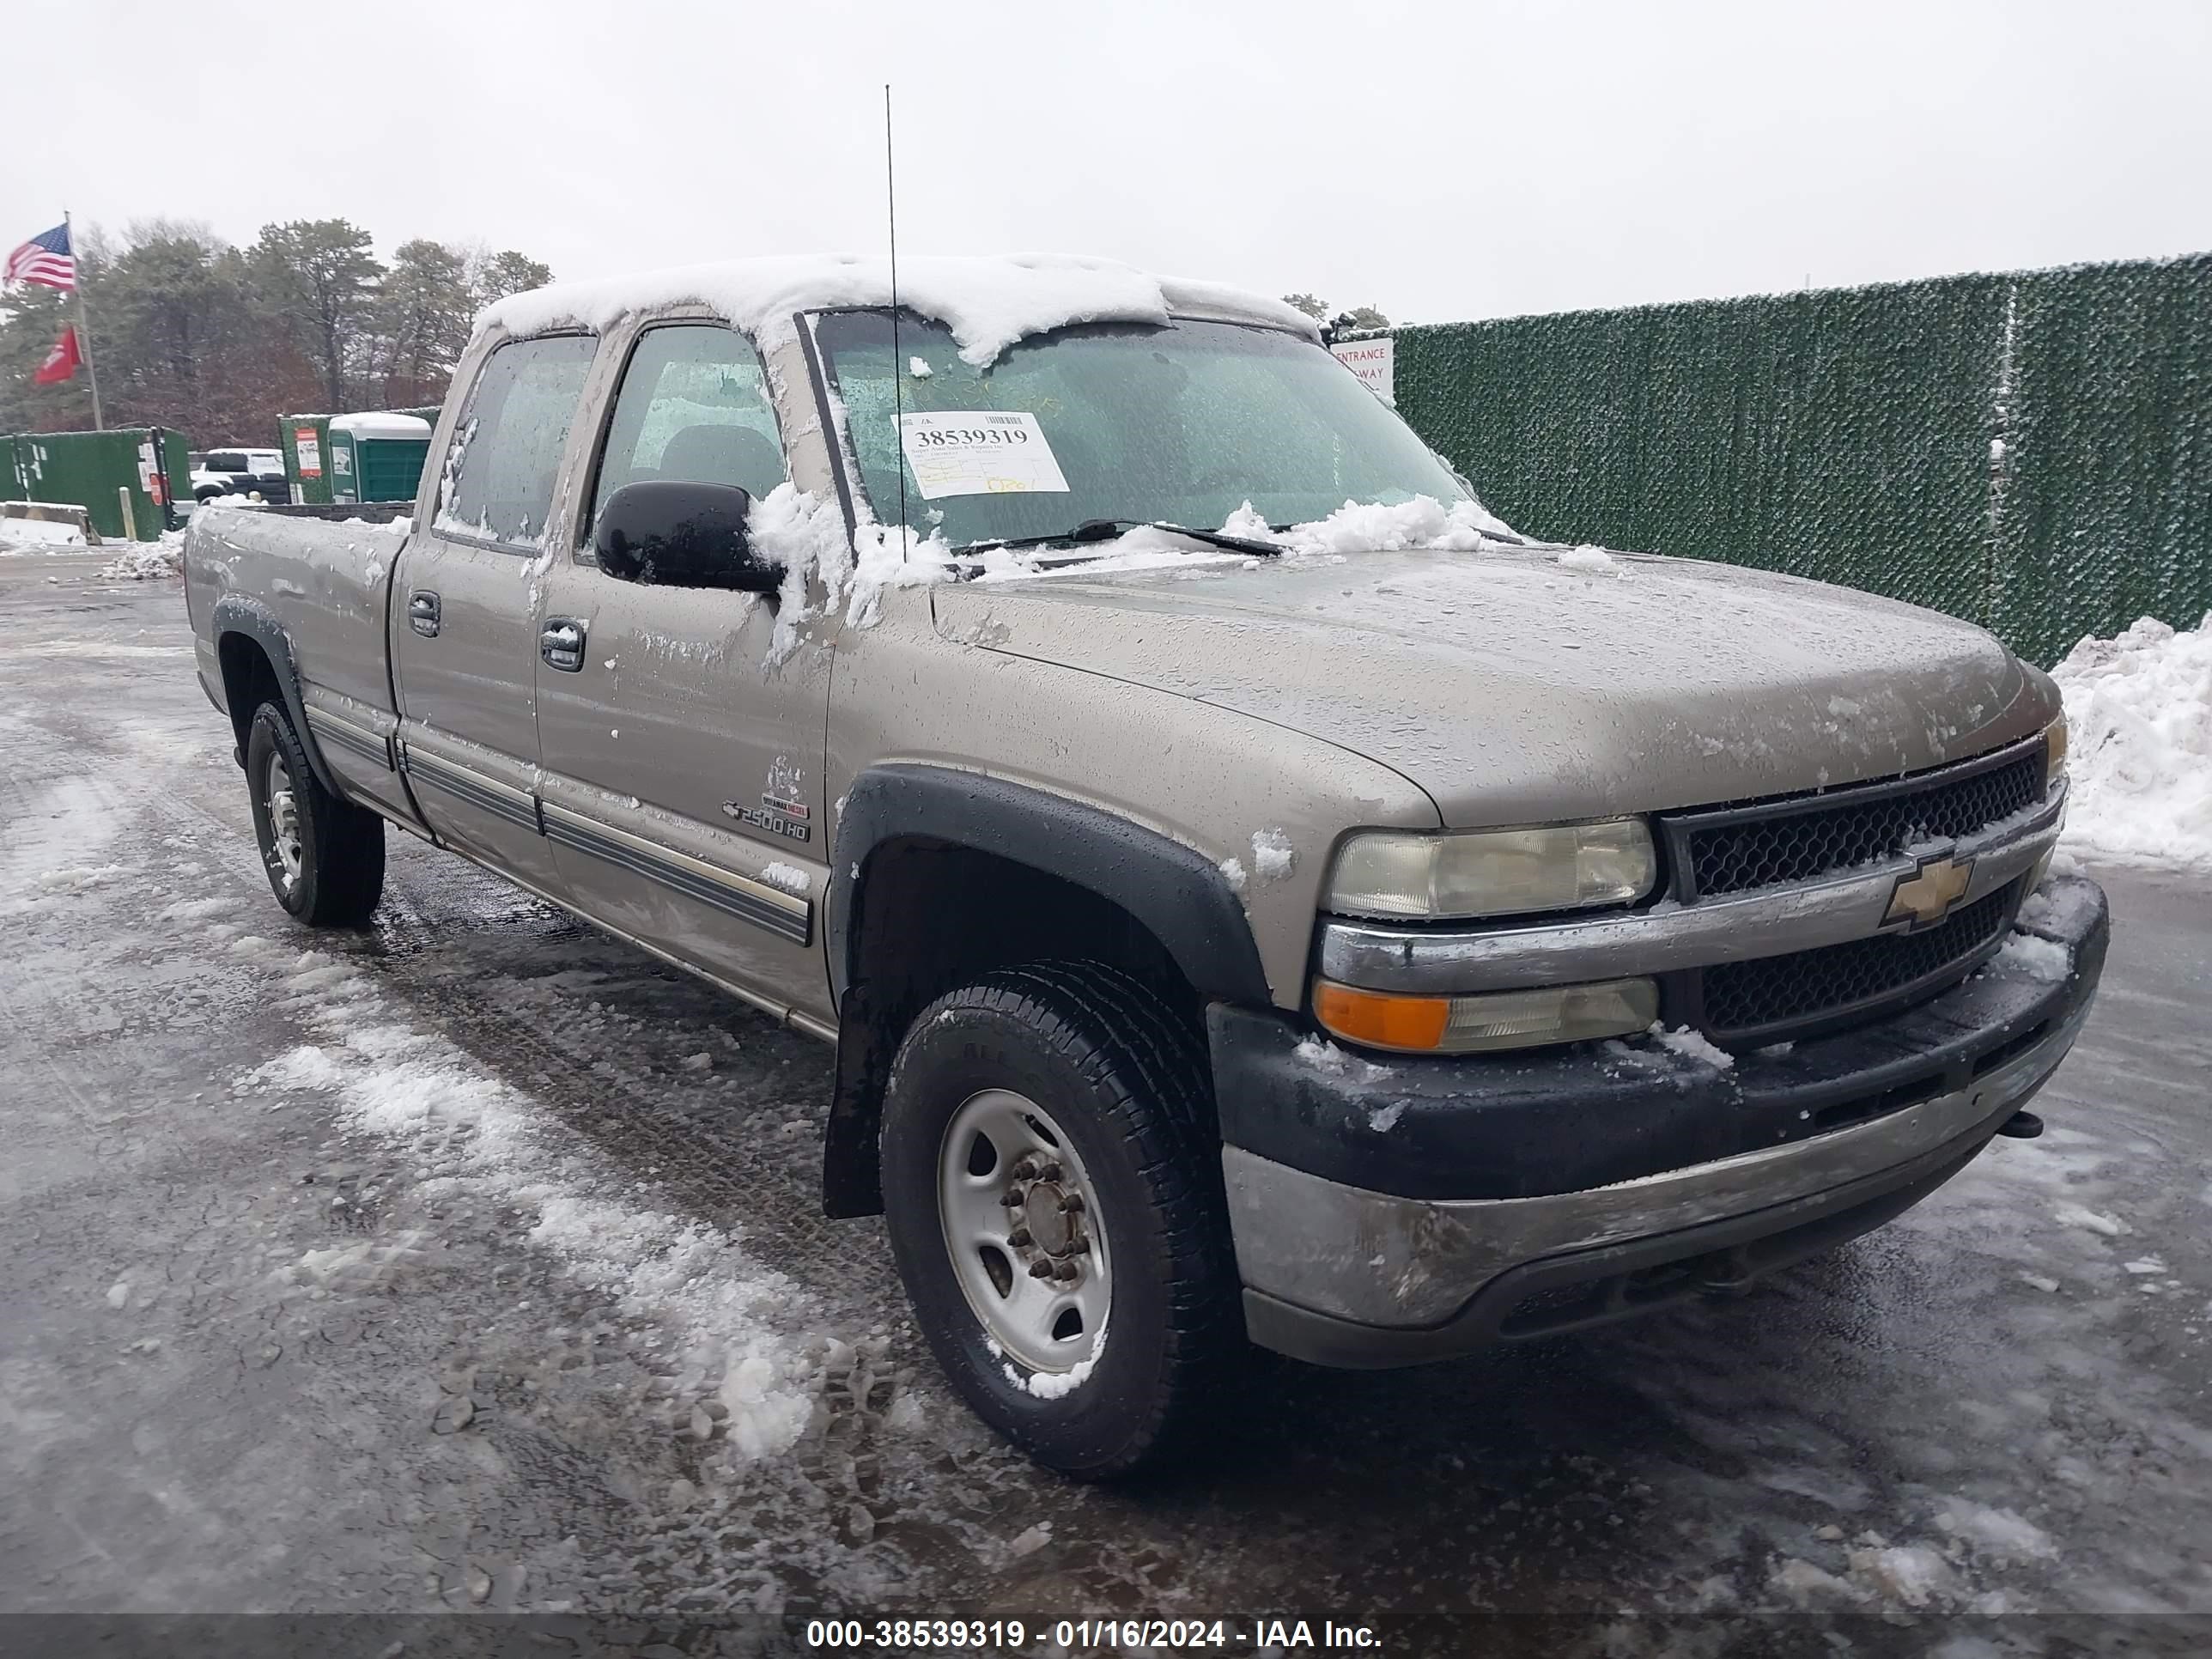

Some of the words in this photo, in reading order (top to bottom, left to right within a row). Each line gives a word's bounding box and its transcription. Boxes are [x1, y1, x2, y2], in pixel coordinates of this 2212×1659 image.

[915, 429, 1029, 447] 38539319
[742, 809, 784, 834] 2500
[787, 823, 805, 840] HD
